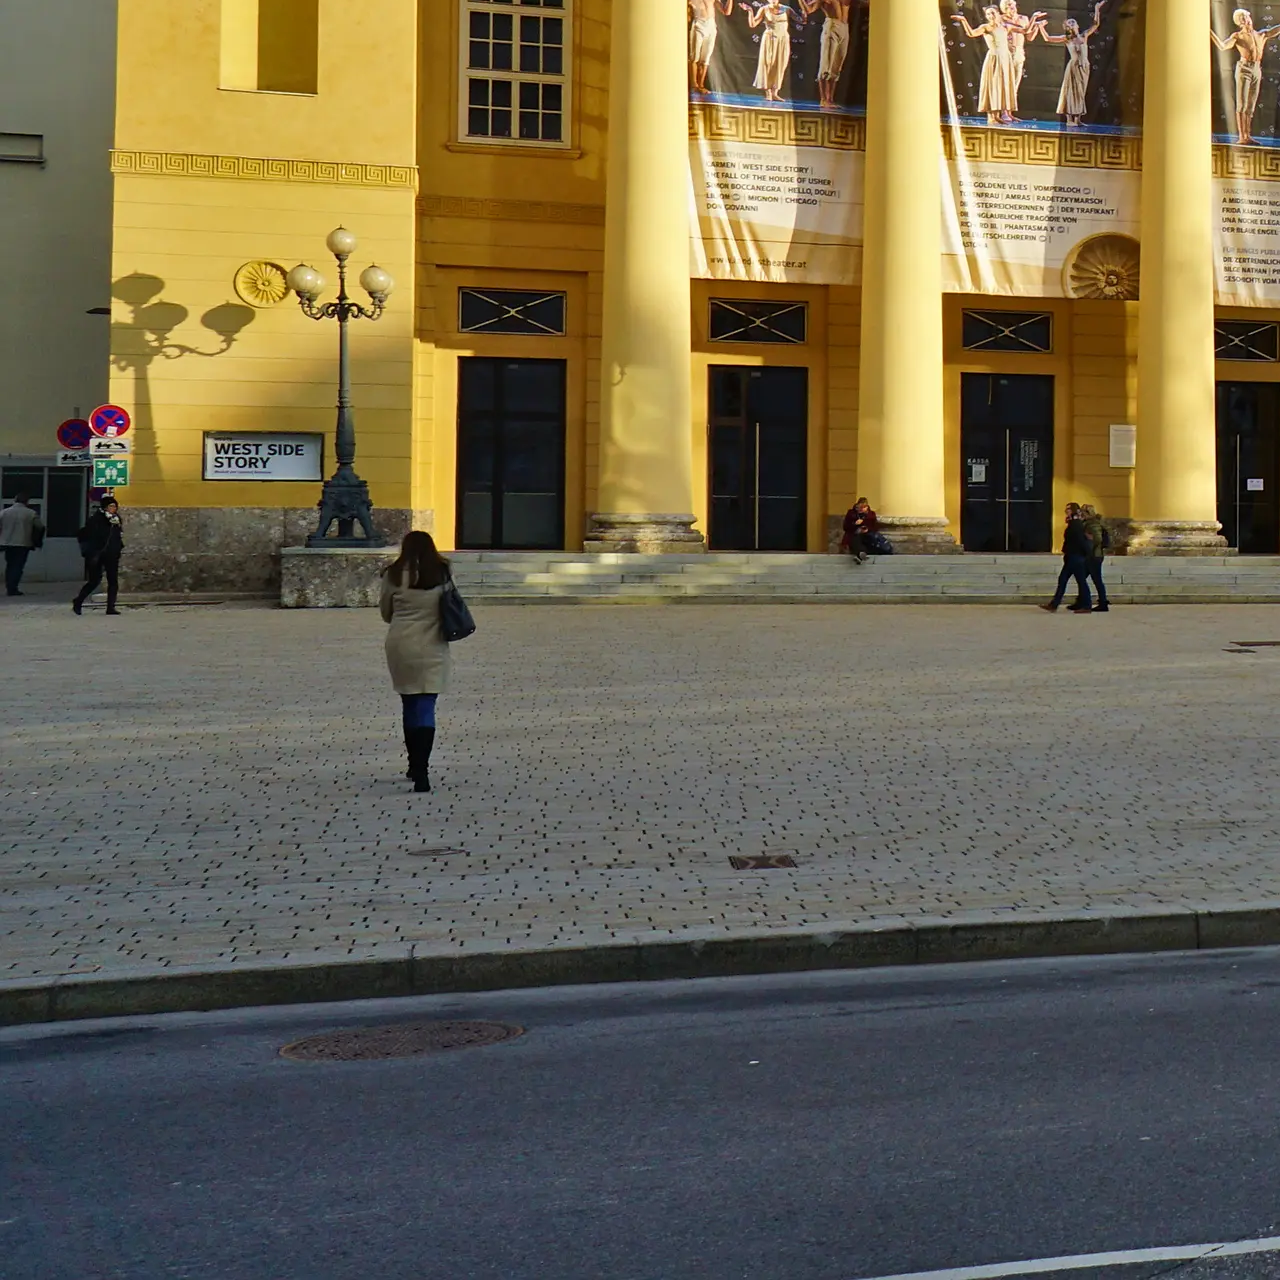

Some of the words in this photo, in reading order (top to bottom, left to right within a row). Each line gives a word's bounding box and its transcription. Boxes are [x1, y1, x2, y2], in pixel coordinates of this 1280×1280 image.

[742, 163, 763, 171] WEST
[784, 166, 809, 174] STORY
[731, 183, 781, 192] BOCCANEGRA
[788, 188, 812, 196] HELLO,
[1034, 185, 1081, 193] VOMPERLOCH
[748, 195, 779, 203] MIGNON
[1036, 196, 1103, 205] RADETZKYMARSCH
[725, 204, 758, 212] GIOVANNI
[1077, 207, 1115, 215] TRAFIKANT
[1004, 224, 1048, 232] PHANTASMA
[214, 443, 262, 455] WEST
[267, 444, 304, 456] SIDE
[214, 457, 270, 468] STORY
